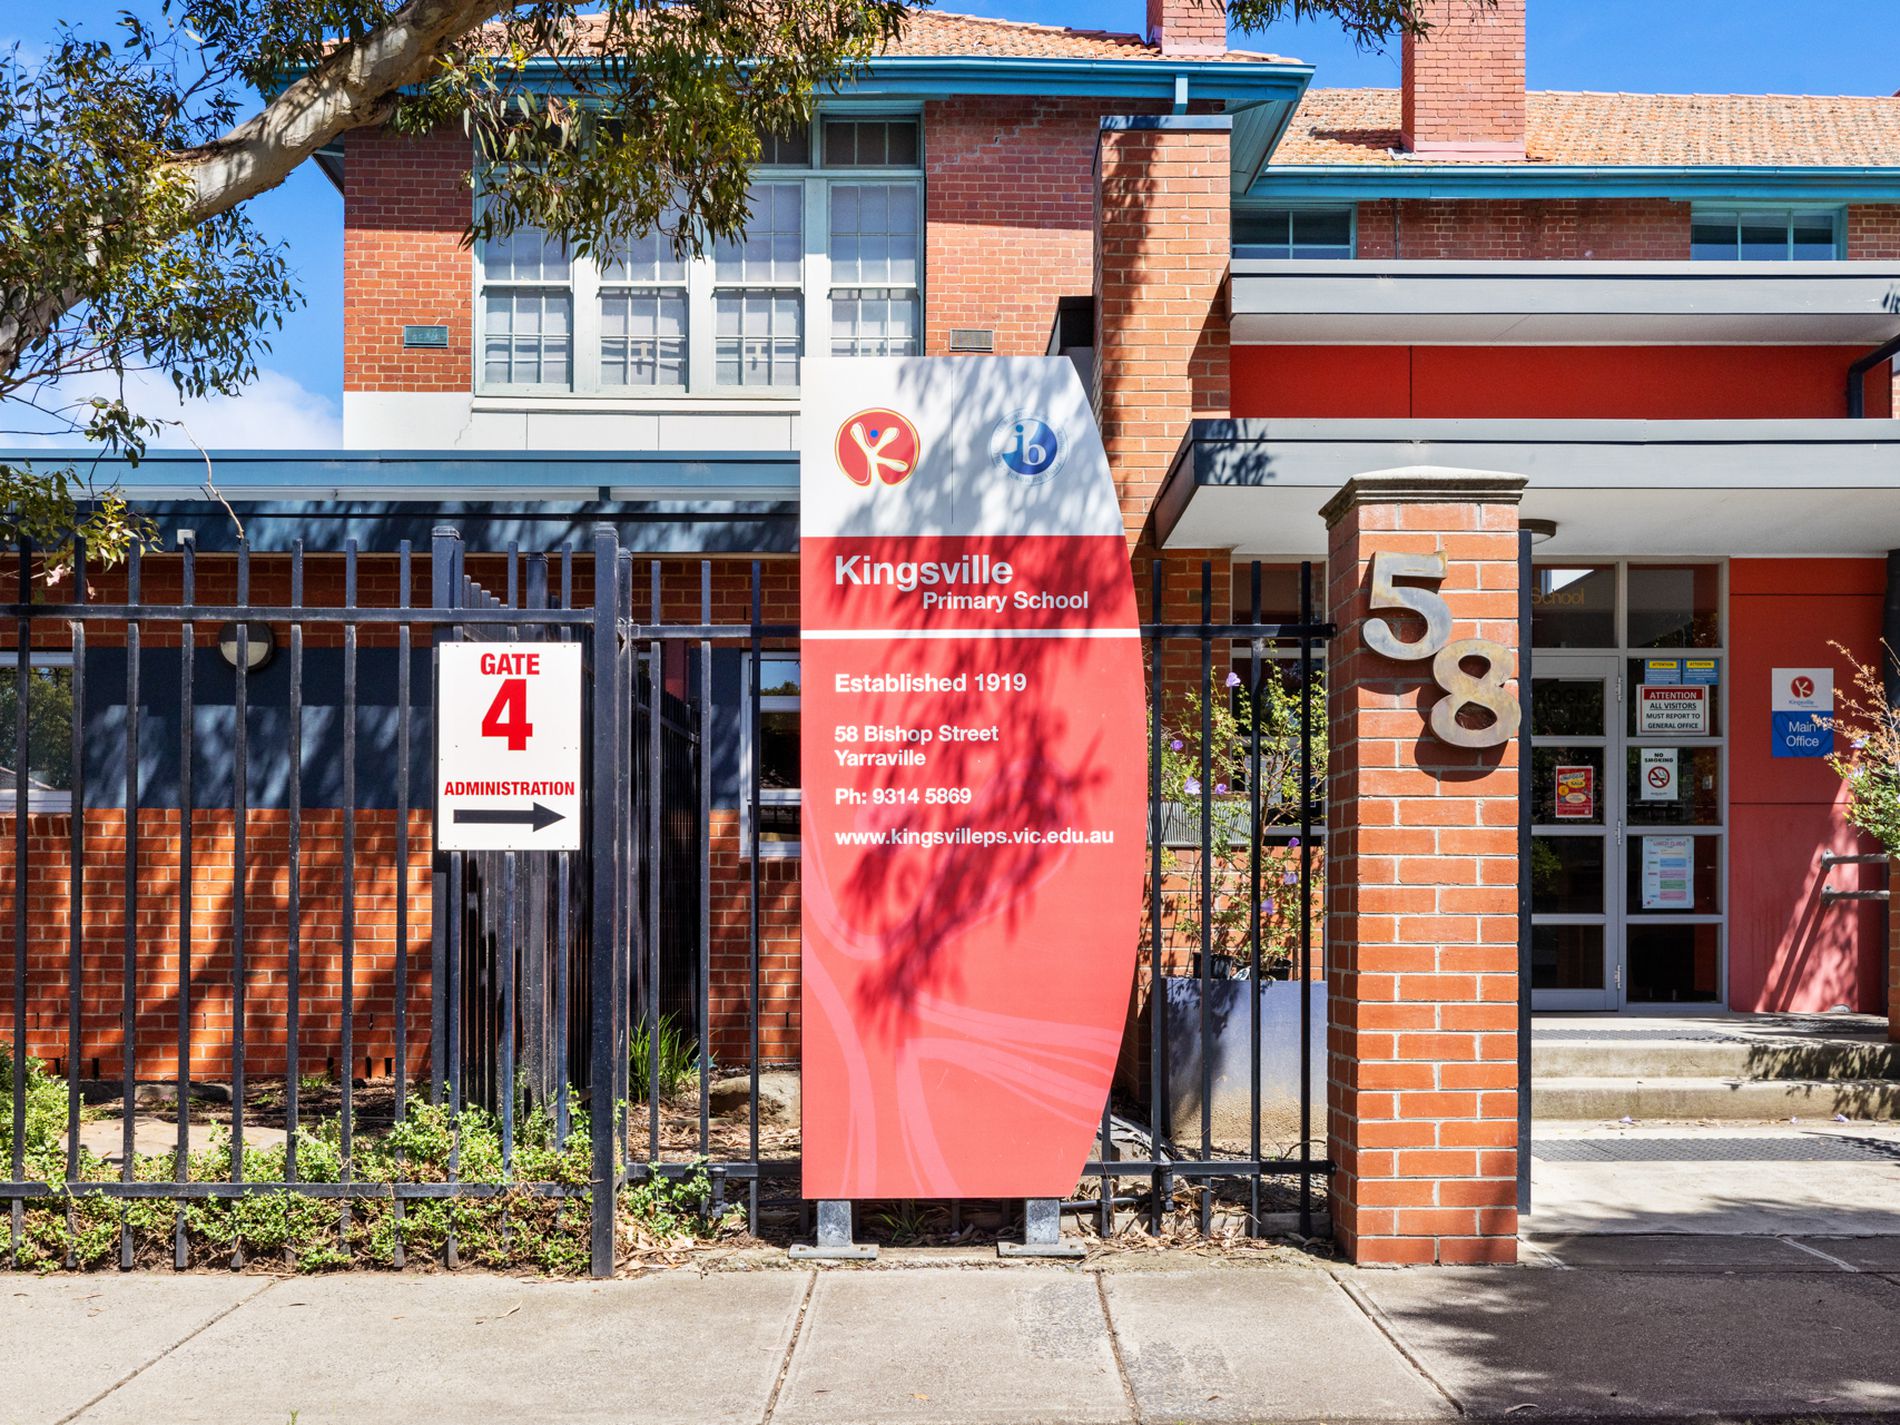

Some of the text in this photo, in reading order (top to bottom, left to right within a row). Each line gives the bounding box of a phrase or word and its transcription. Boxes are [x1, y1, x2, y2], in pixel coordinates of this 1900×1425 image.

[834, 555, 1014, 590] Kingsville
[923, 590, 1088, 614] Primary School
[480, 652, 540, 676] GATE
[833, 673, 1027, 693] Established 1919
[1649, 691, 1697, 700] ATTENTION
[481, 678, 534, 751] 4
[1649, 702, 1697, 710] ALL VISITORS
[833, 725, 999, 746] 58 Bishop Street
[1788, 720, 1817, 733] Main
[1785, 735, 1820, 747] Office
[833, 749, 927, 768] Yarraville
[444, 781, 575, 796] ADMINISTRATION
[833, 787, 973, 805] Ph: 9314 5869
[833, 824, 1116, 850] www.kingsvilleps.vic.edu.au
